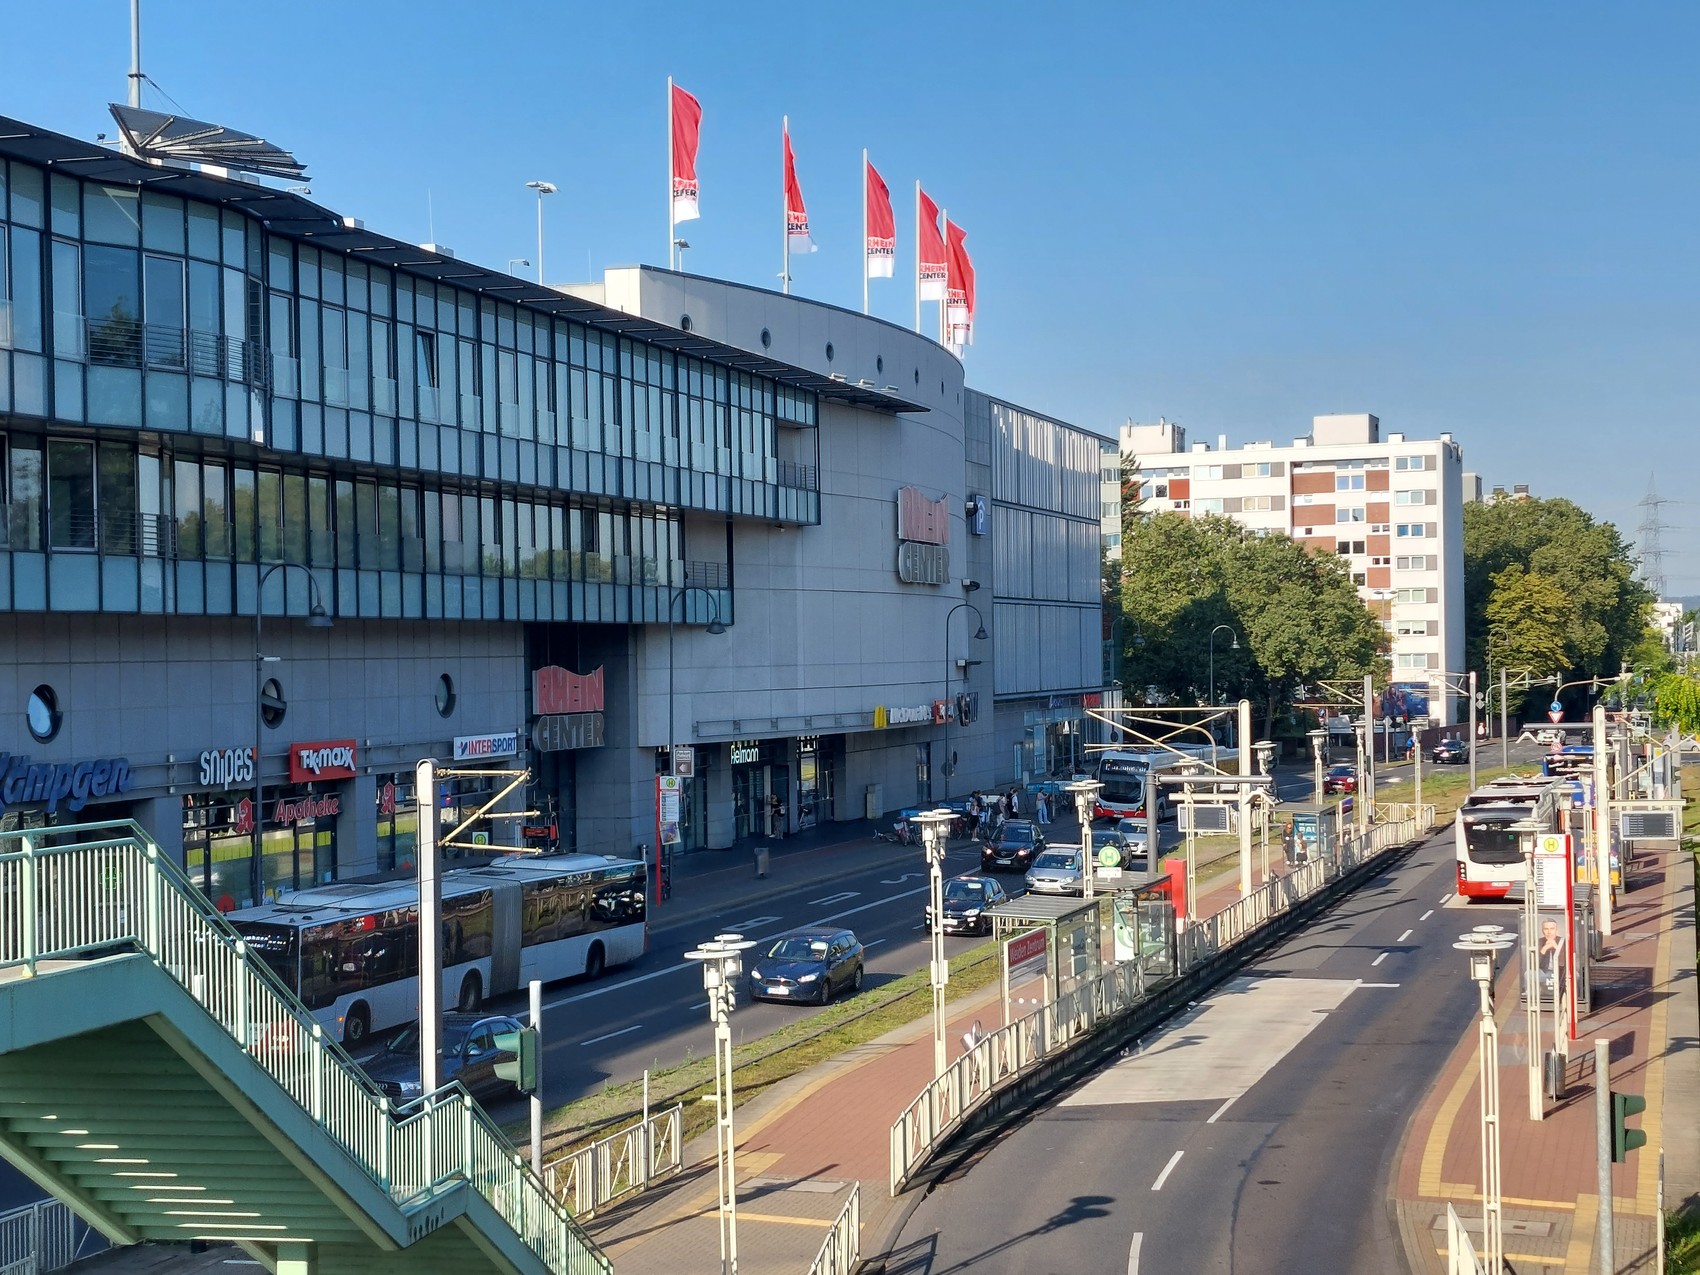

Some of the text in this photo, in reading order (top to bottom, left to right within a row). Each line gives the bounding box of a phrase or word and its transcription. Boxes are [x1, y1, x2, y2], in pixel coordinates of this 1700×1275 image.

[535, 664, 604, 715] RHEIN
[468, 737, 517, 756] INTERSPORT
[534, 712, 605, 752] CENTER
[274, 793, 339, 827] Apotheke
